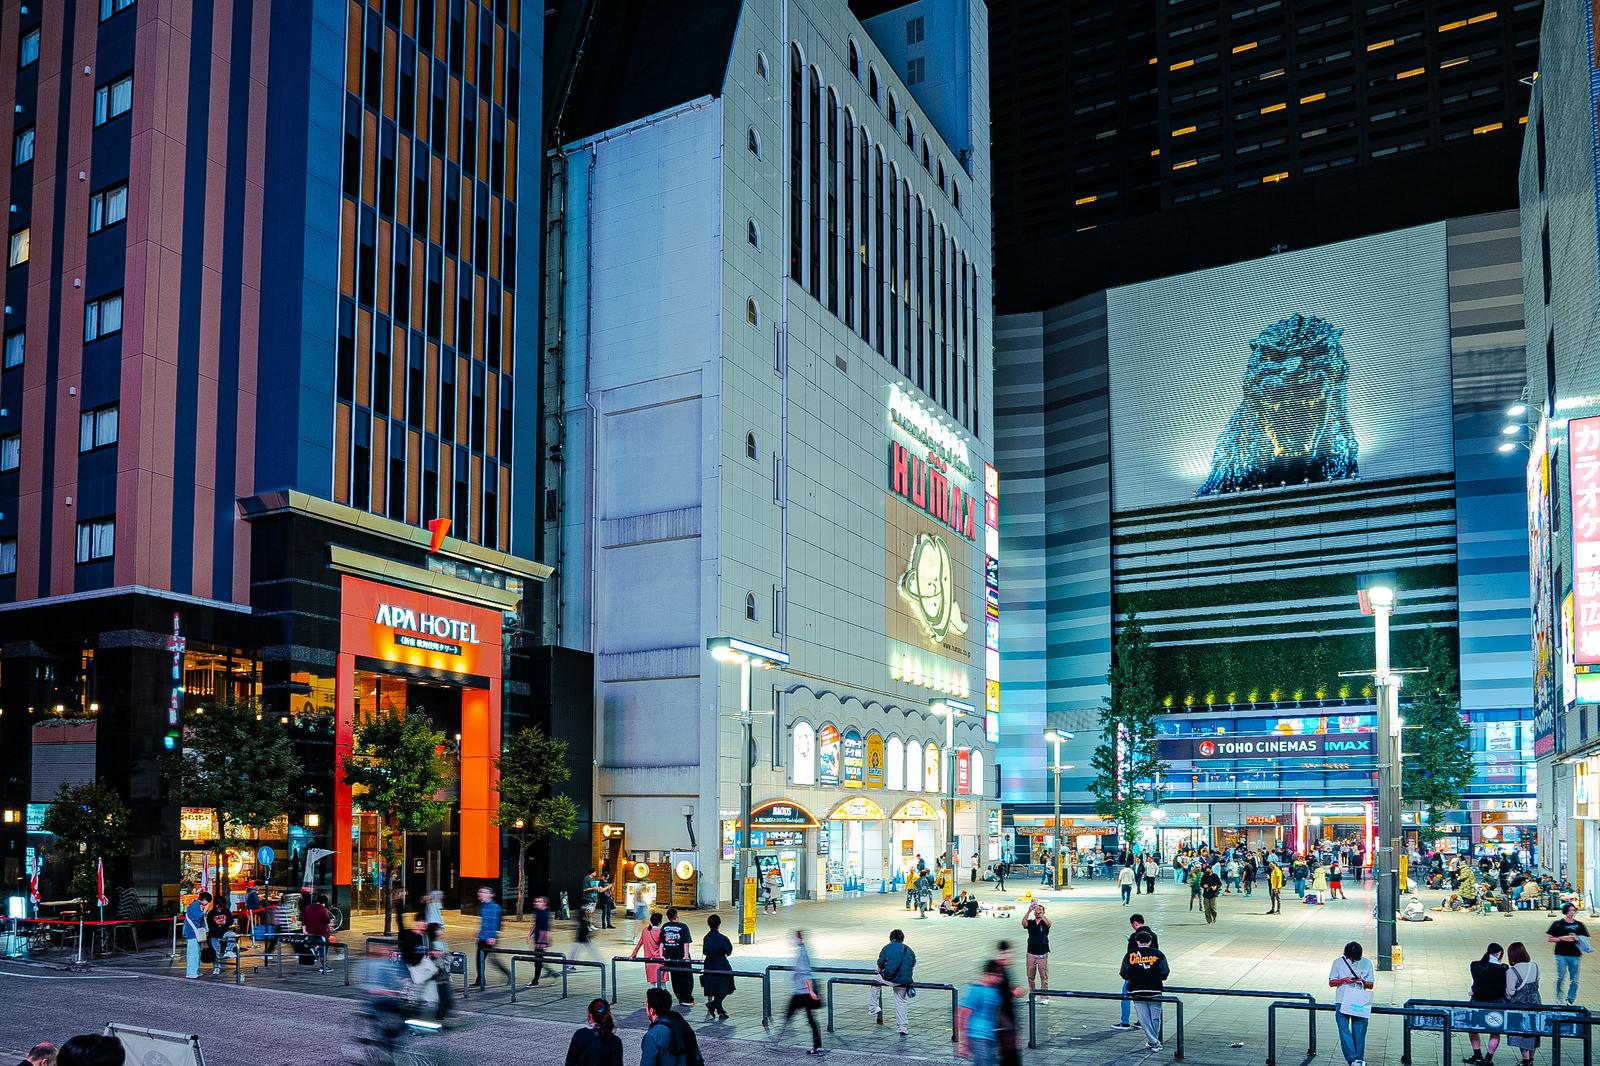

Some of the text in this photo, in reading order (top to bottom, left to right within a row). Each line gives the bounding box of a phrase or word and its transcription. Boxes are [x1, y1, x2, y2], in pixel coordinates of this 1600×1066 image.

[892, 440, 976, 542] HUMAX
[375, 604, 480, 643] APA HOTEL
[1218, 739, 1370, 754] TOHO CINEMAS IMAX
[1129, 952, 1159, 965] Chicago
